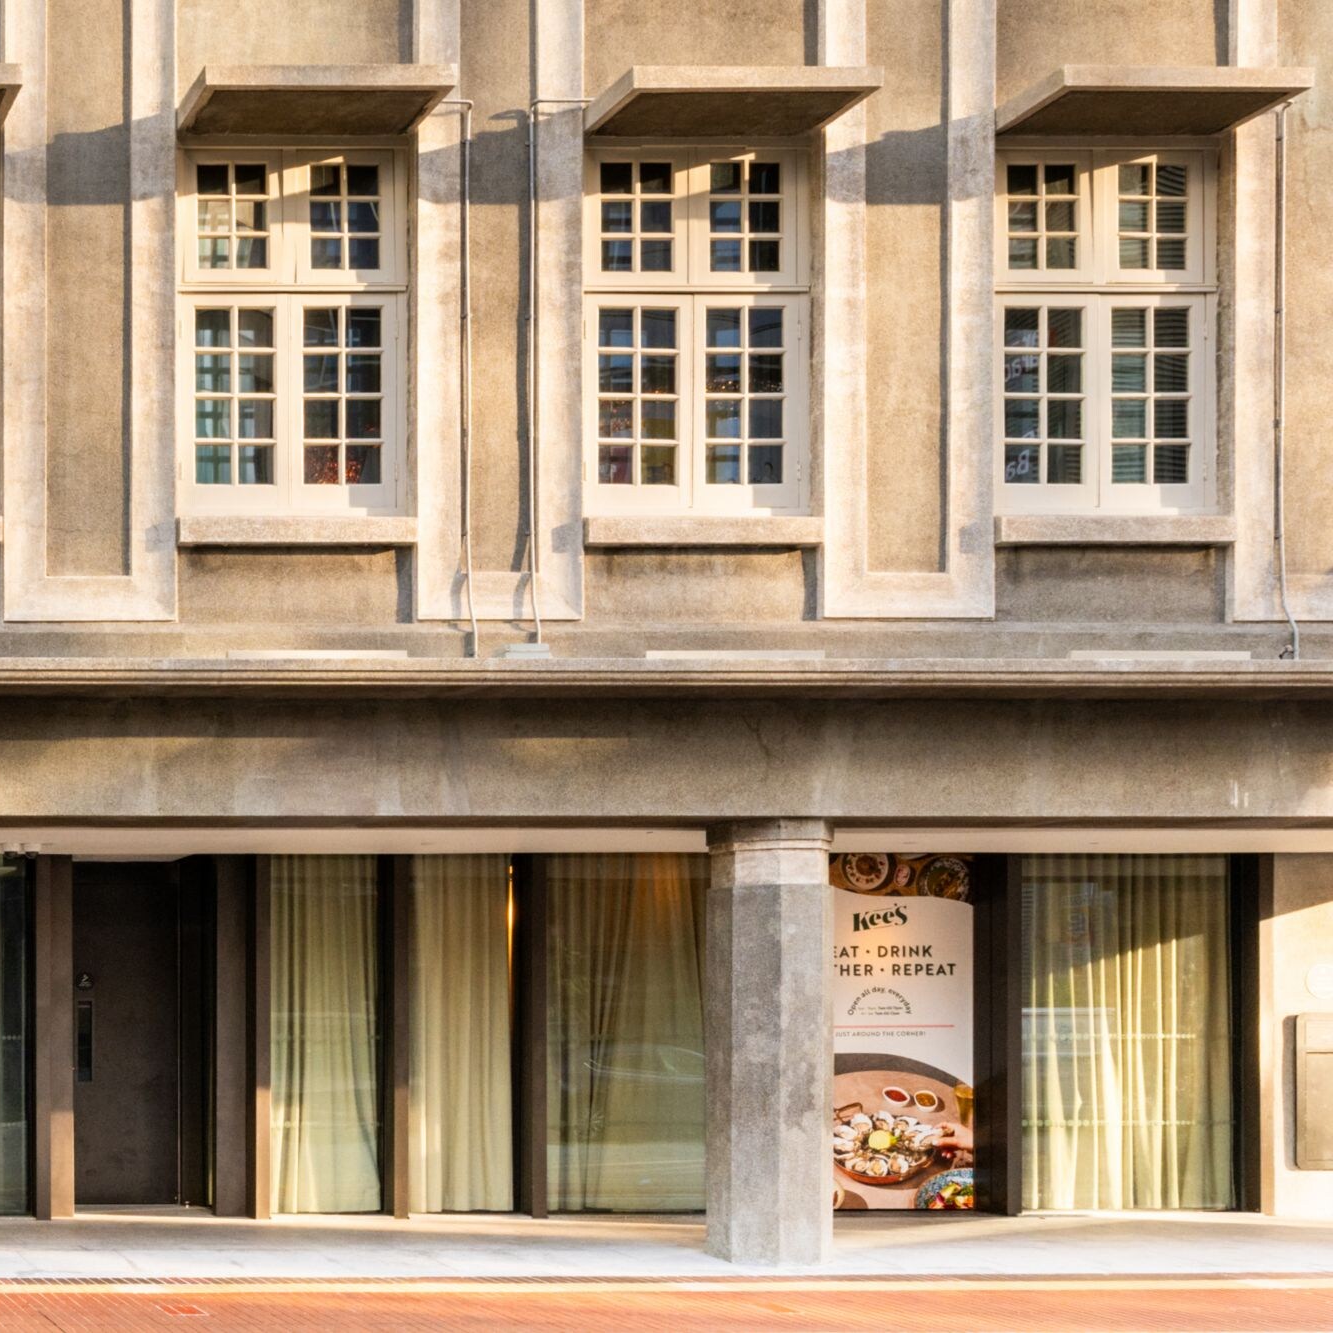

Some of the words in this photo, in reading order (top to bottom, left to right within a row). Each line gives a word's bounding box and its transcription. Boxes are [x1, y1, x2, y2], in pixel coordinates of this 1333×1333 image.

[877, 945, 933, 958] DRINK
[833, 964, 874, 977] HER
[892, 963, 957, 977] REPEAT
[847, 996, 862, 1016] Open
[861, 988, 871, 998] all
[887, 988, 913, 1015] everyday
